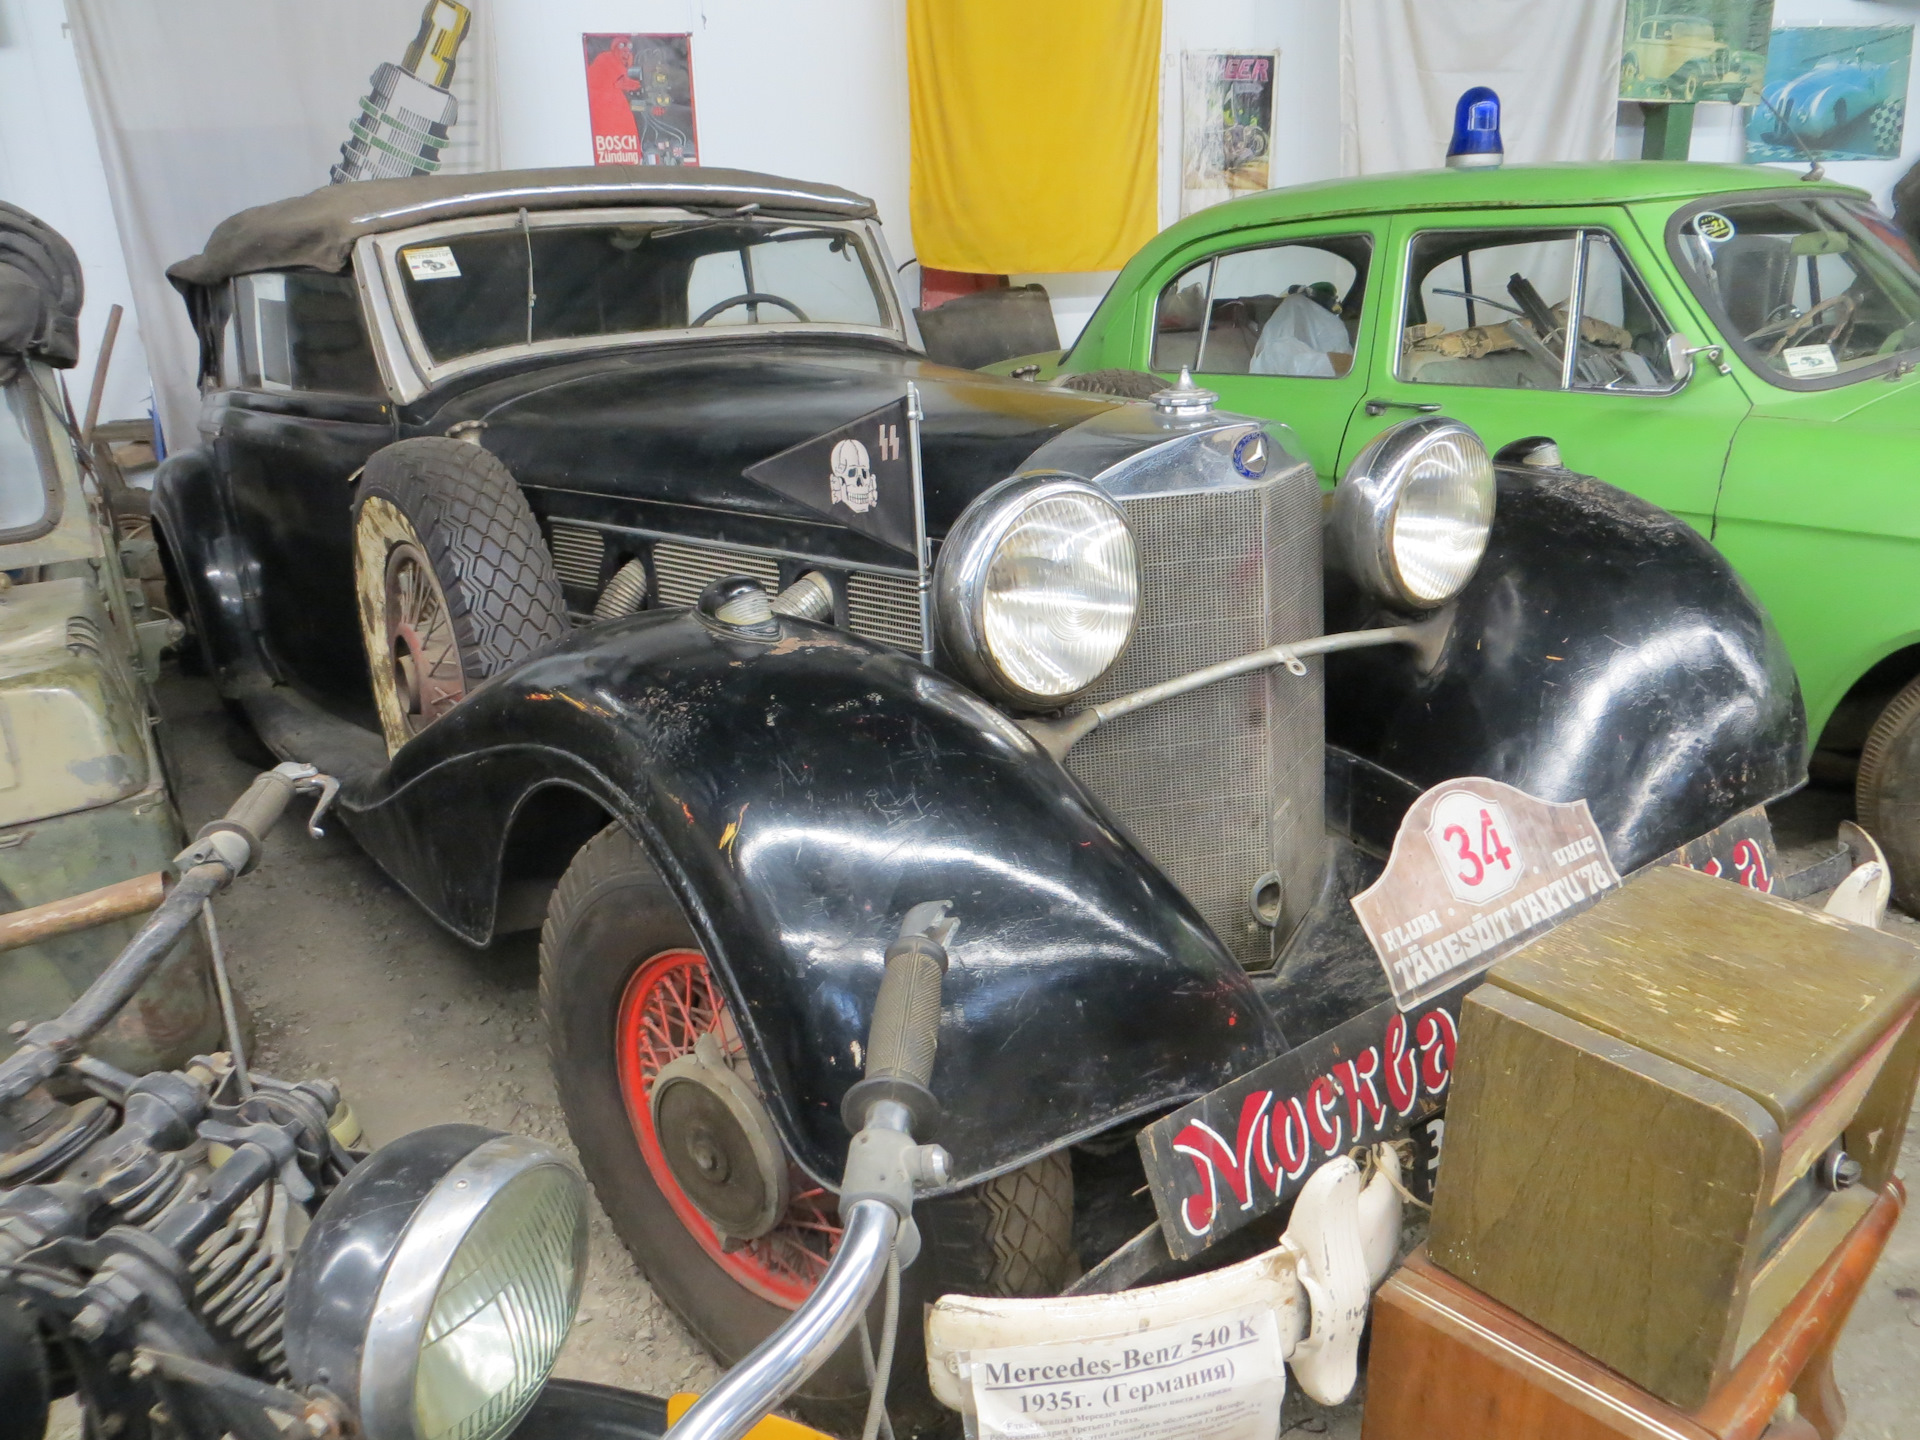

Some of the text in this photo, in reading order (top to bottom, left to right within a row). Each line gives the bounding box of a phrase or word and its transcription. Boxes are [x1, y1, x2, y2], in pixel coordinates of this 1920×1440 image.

[595, 135, 638, 151] BOSCH
[598, 150, 639, 164] Zündung
[1443, 808, 1512, 886] 34
[1381, 909, 1443, 952] KLUBI
[1394, 907, 1514, 990] TÄHESÕIT
[985, 1318, 1259, 1386] Mercedes-Benz 540 K
[1019, 1358, 1235, 1413] 1935г. (Германия)
